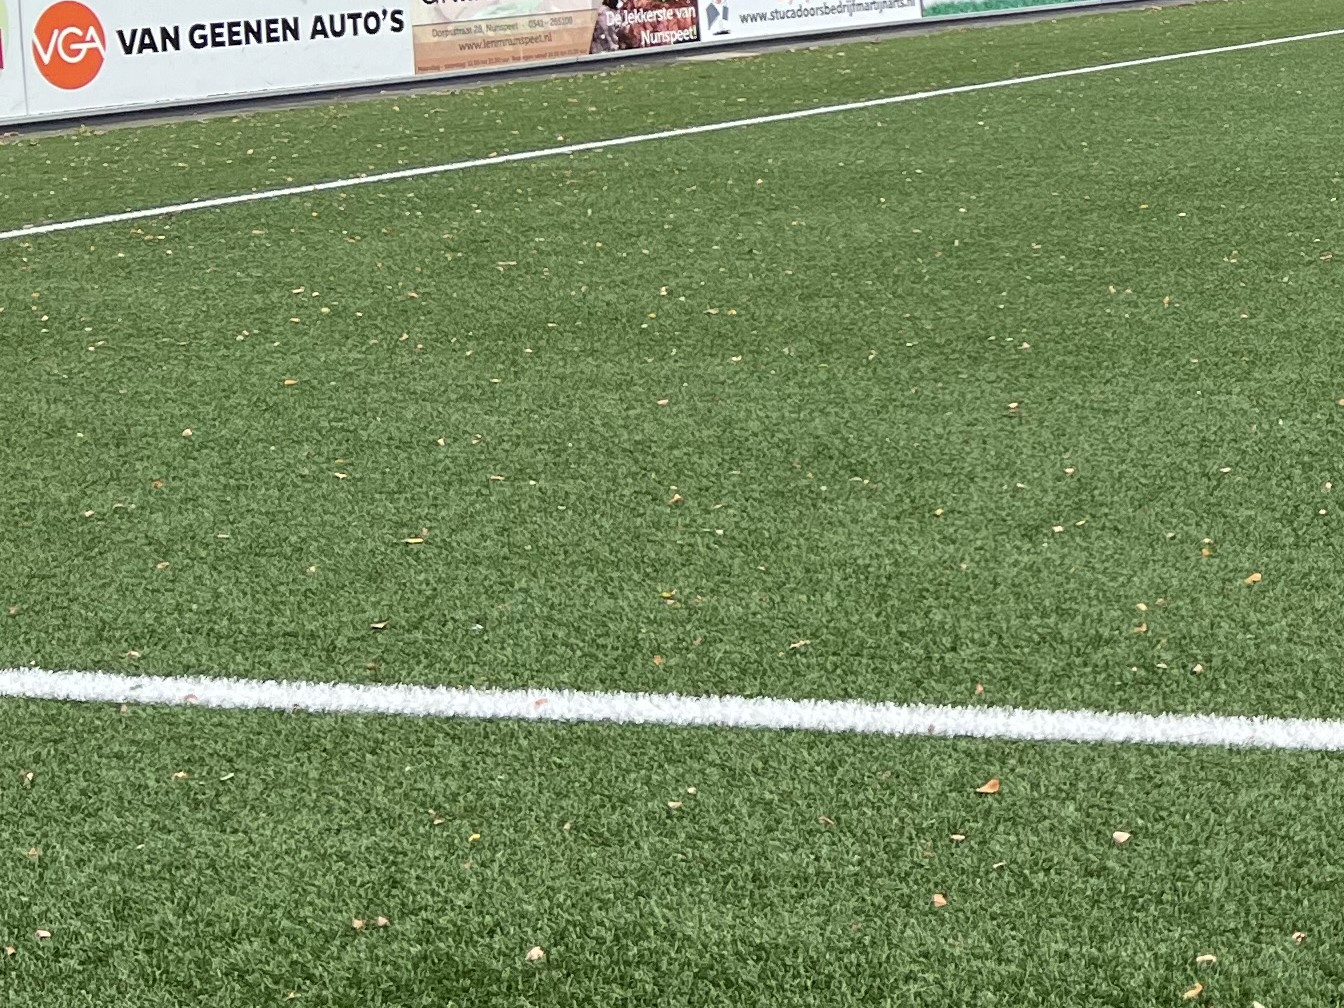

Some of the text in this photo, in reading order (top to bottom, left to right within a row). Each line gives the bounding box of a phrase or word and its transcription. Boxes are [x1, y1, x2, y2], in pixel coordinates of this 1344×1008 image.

[116, 8, 405, 55] VAN GEENEN AUTO'S
[606, 6, 696, 27] De lekkerste van
[33, 25, 105, 65] VGA
[640, 28, 697, 47] Nunspeet!
